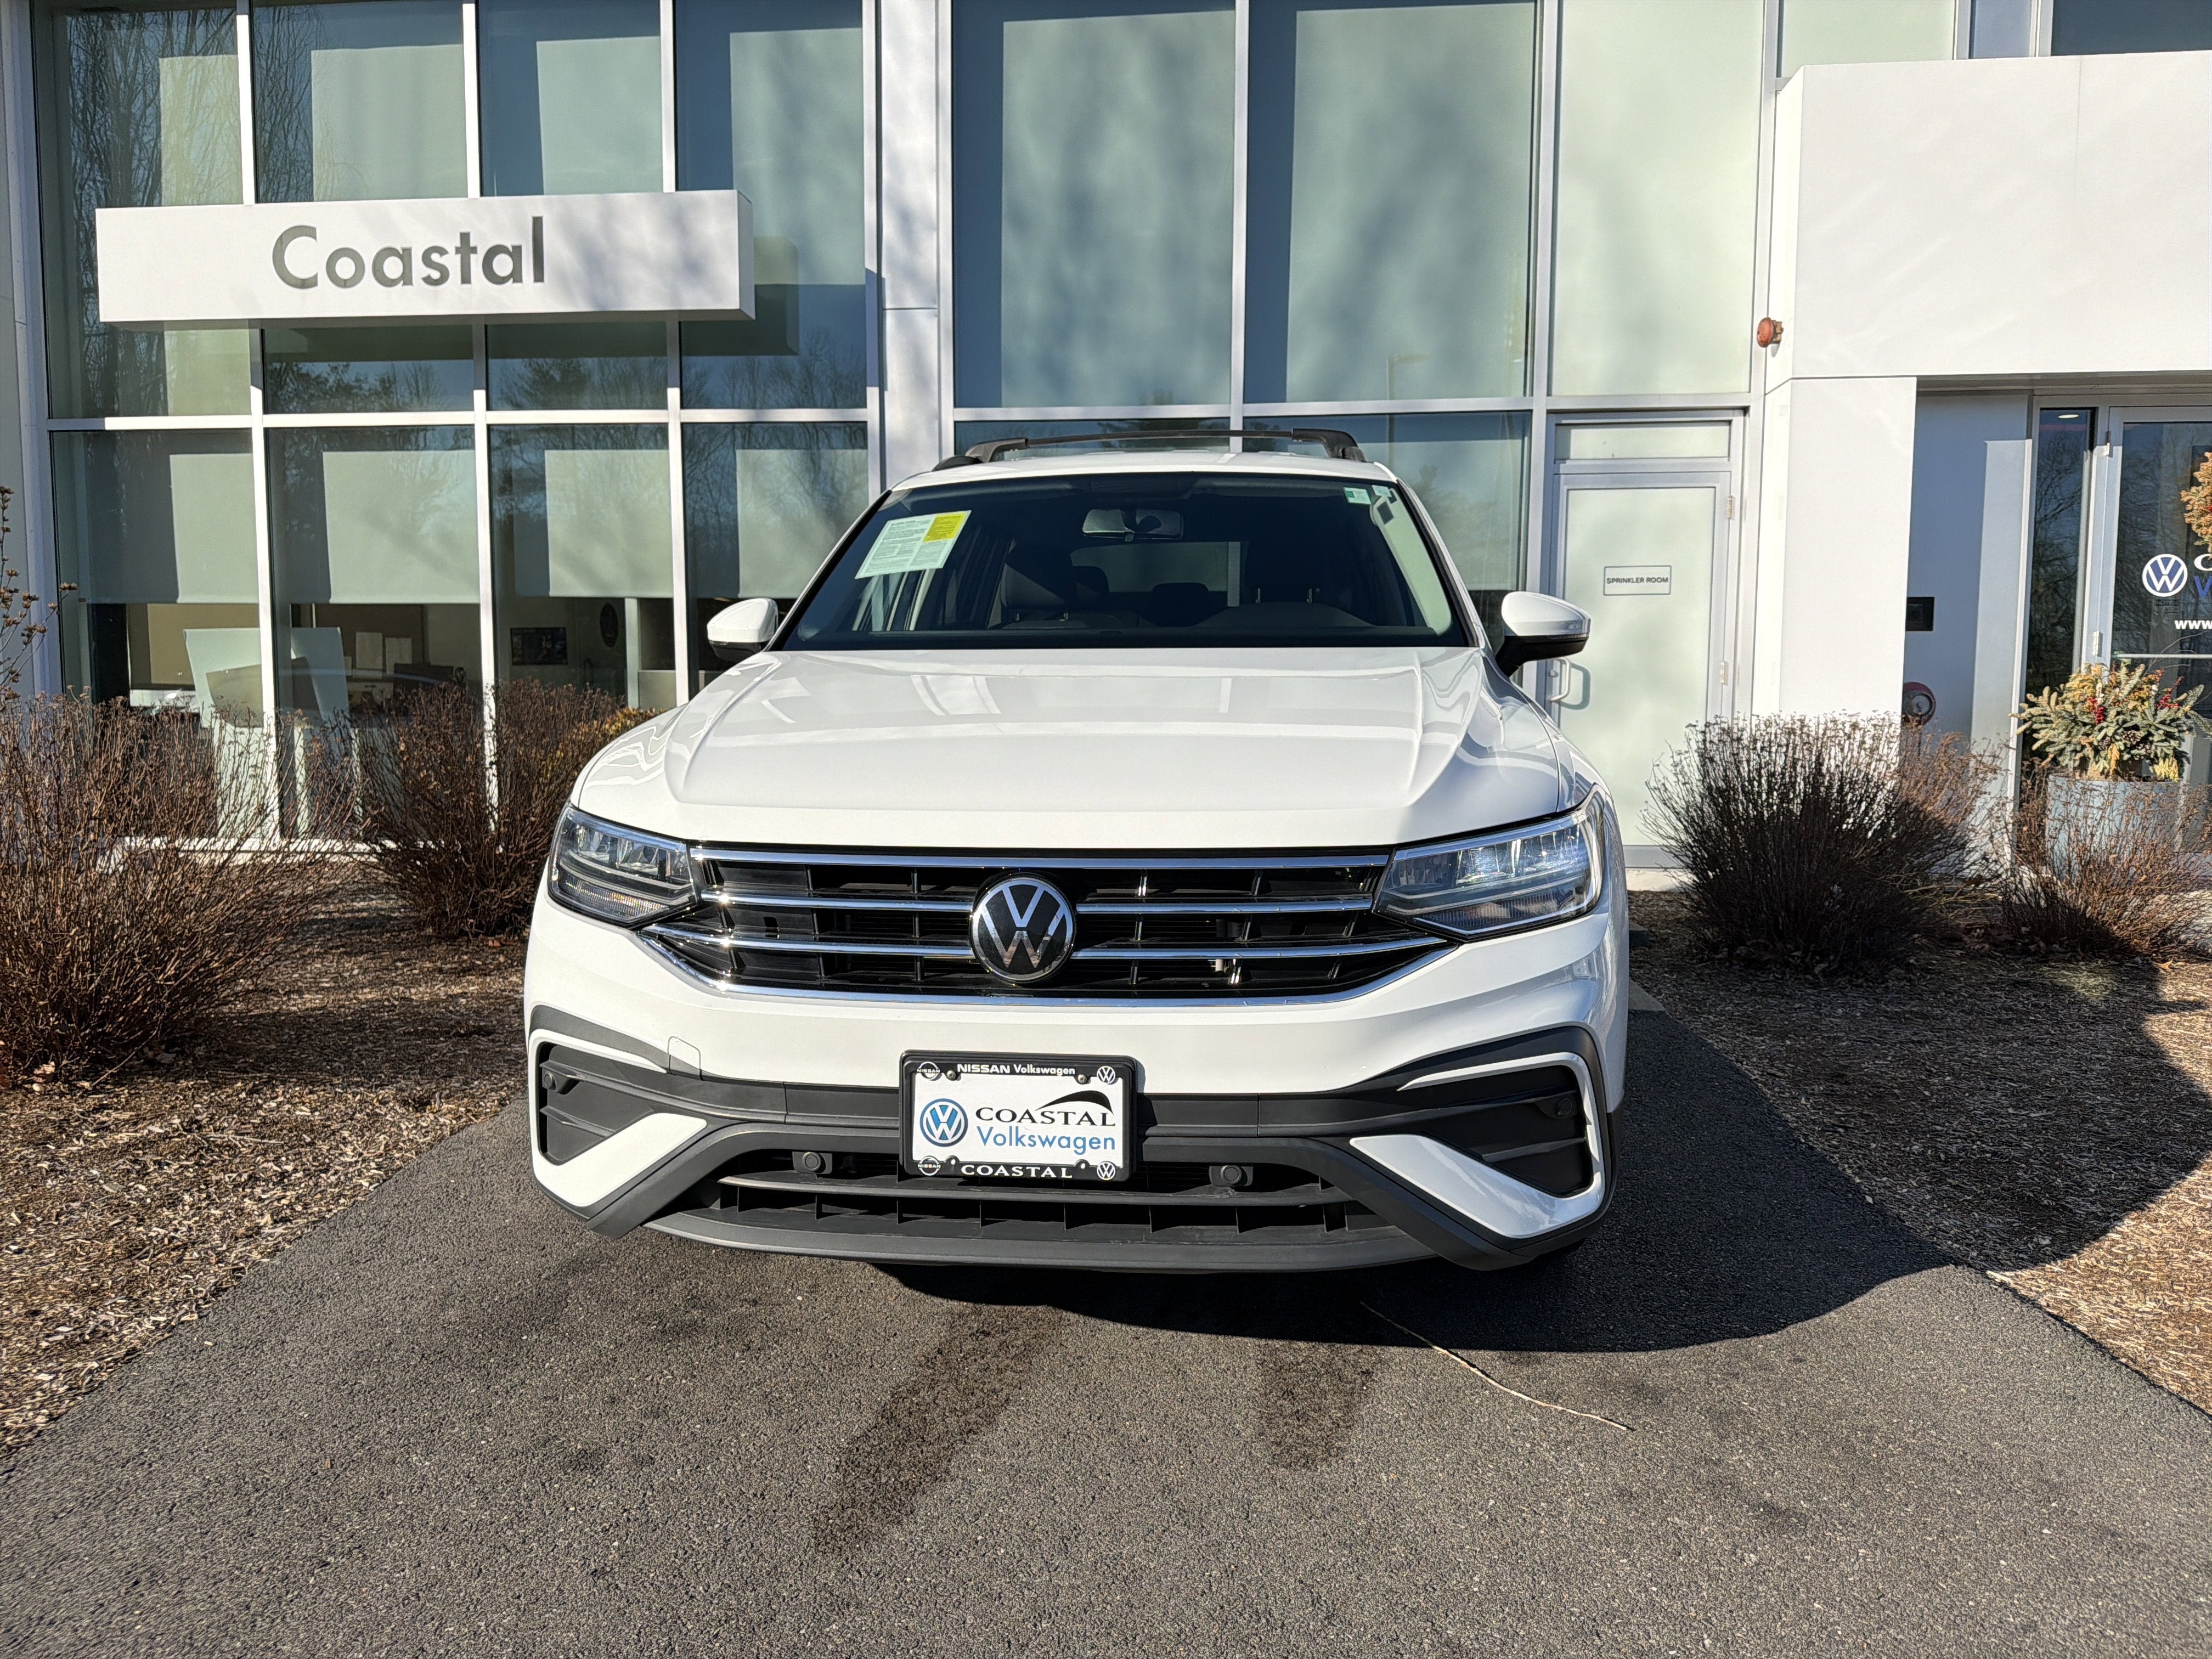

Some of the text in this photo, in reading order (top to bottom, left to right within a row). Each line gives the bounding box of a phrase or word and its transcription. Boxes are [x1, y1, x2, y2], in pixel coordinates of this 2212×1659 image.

[272, 216, 545, 289] Coastal
[957, 1063, 1076, 1076] NISSAN Volkswagen
[975, 1107, 1116, 1126] COASTAL
[977, 1125, 1115, 1155] Volkswagen
[961, 1165, 1073, 1179] COASTAL
